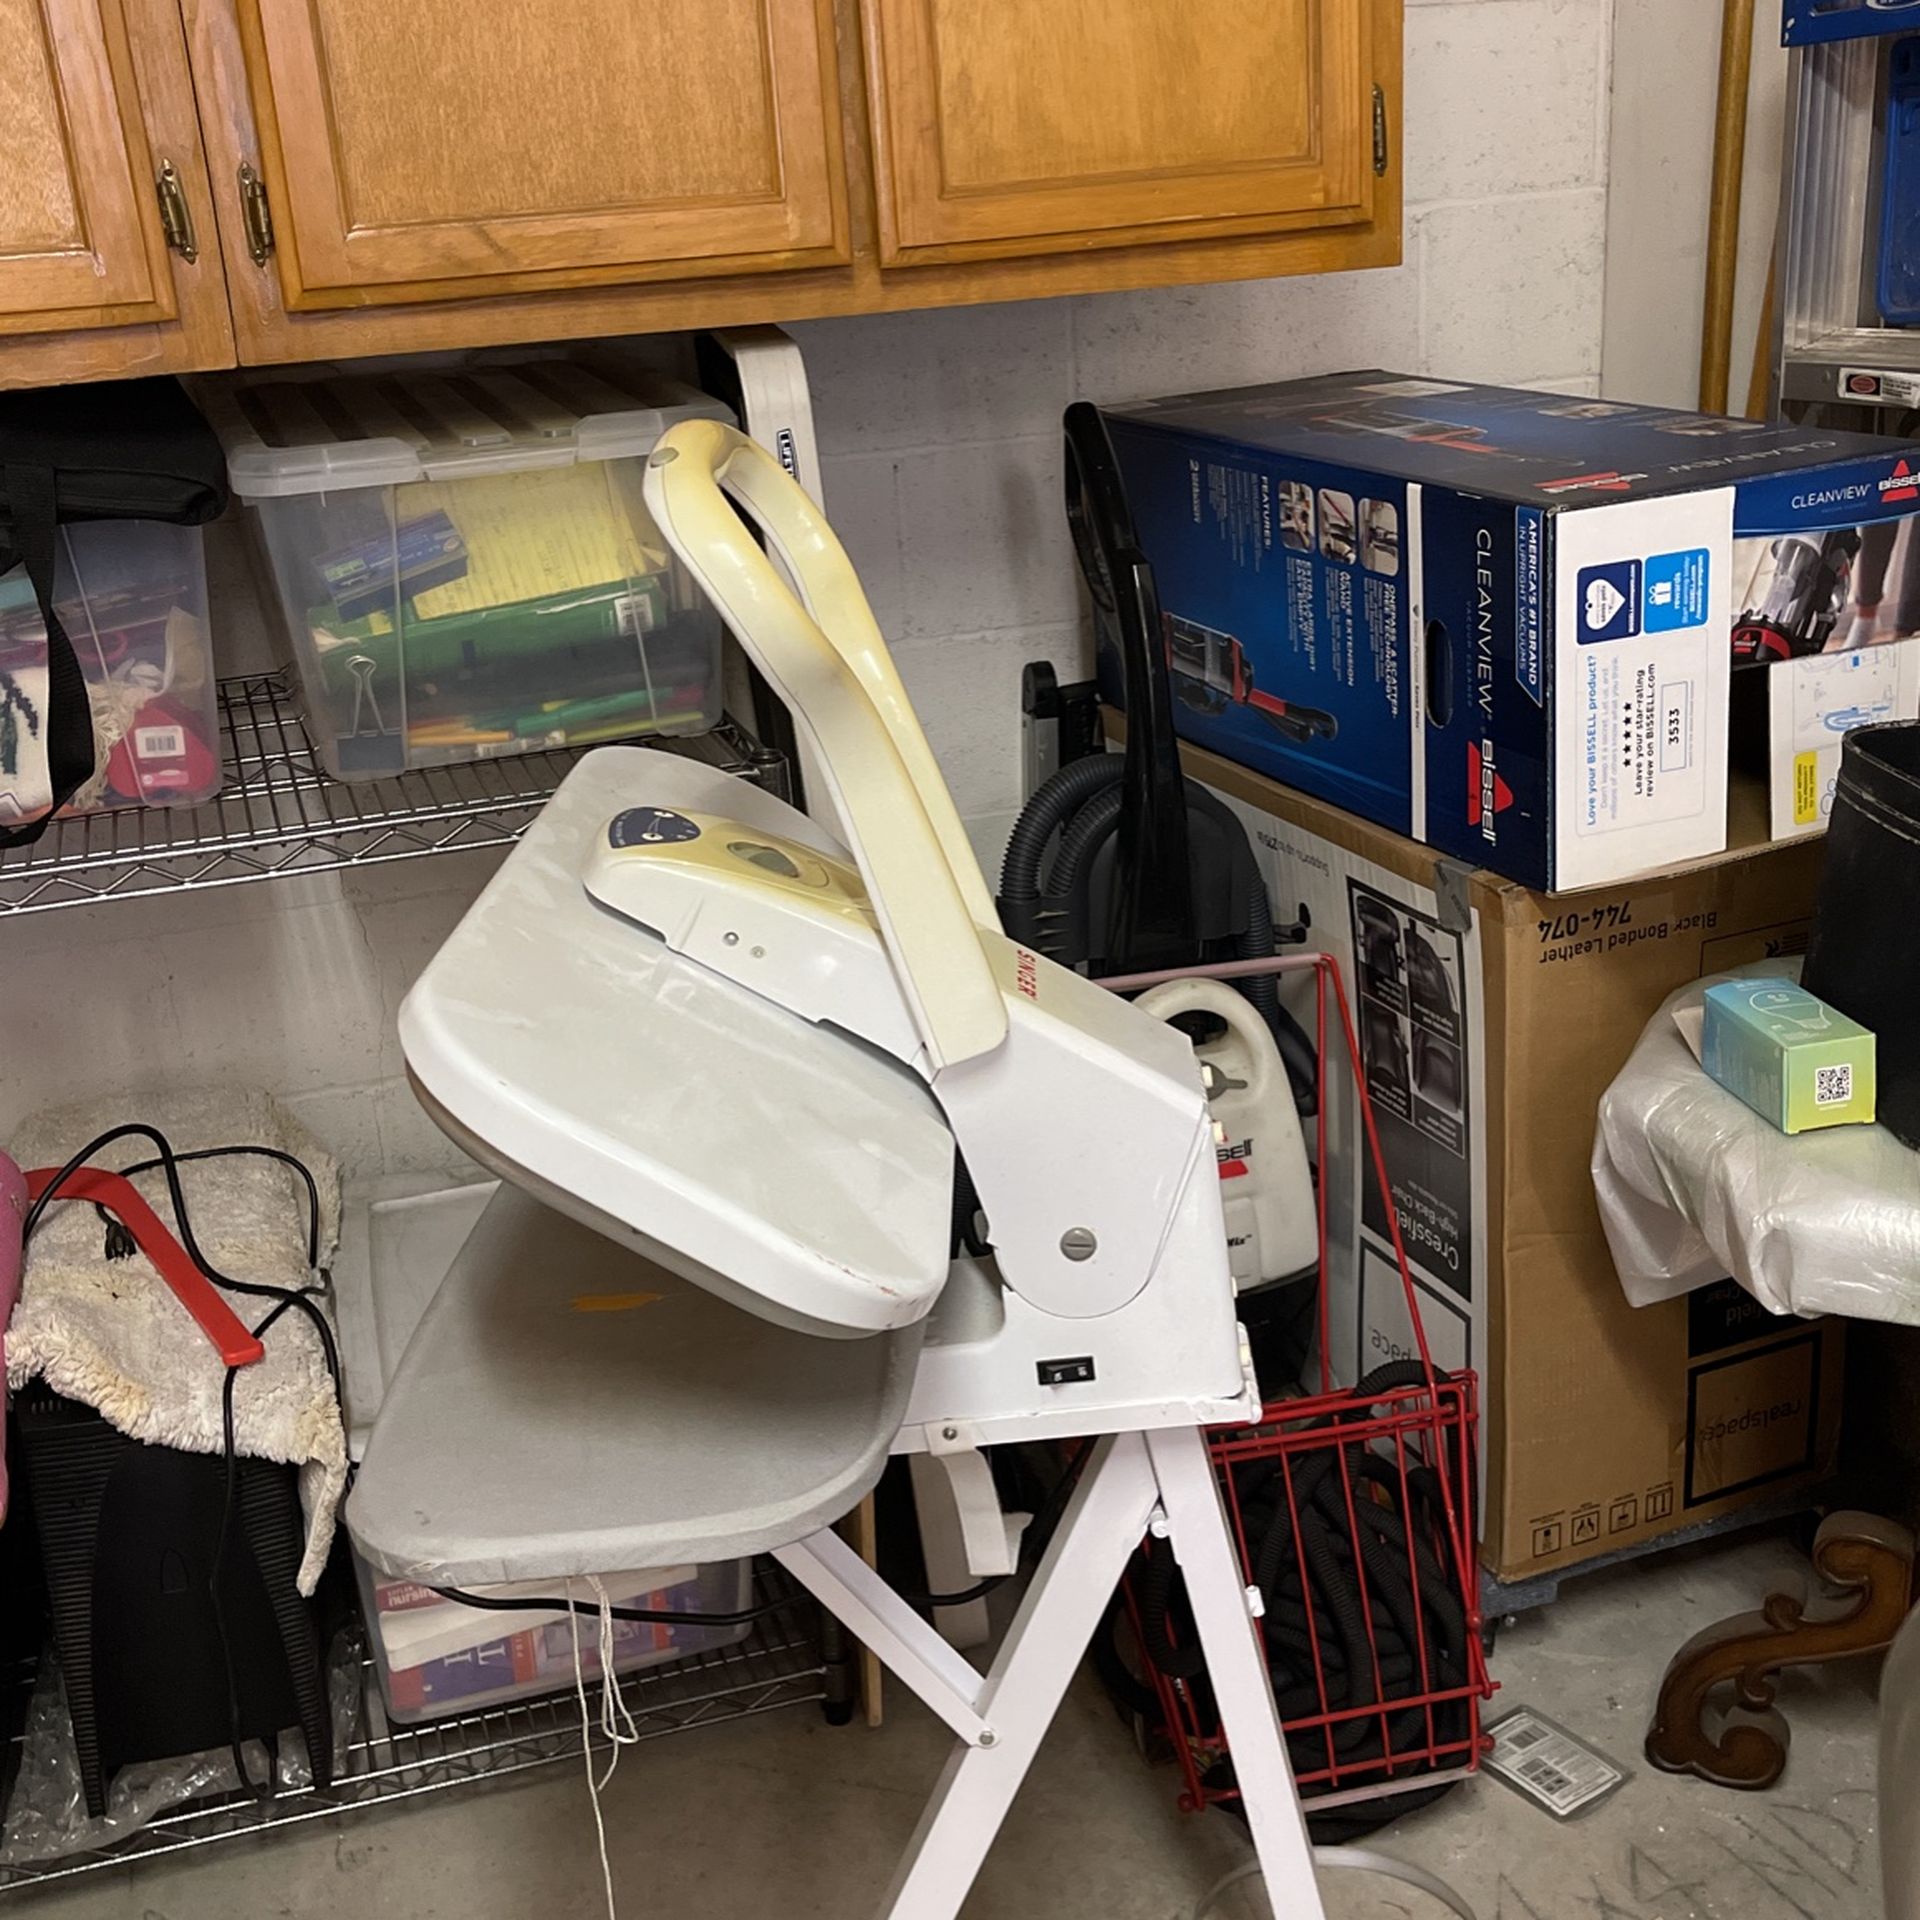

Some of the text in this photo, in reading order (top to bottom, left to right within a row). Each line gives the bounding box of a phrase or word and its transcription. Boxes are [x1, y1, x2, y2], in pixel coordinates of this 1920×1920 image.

[1791, 483, 1871, 510] CLEANVIEW
[1476, 528, 1494, 716] CLEANVIEW
[1519, 526, 1527, 670] IN UPRIGHT VACUUMS
[1529, 518, 1537, 685] AMERICA'S #1 BRAND
[1586, 655, 1597, 826] Love your BISSELL product?
[1634, 670, 1645, 796] Leave your star-rating
[1645, 663, 1655, 797] review on BISSELL.com
[1668, 708, 1681, 746] 3533
[1537, 900, 1632, 943] 744-074
[1538, 936, 1603, 964] Leather
[1608, 922, 1669, 948] Bonded
[1017, 949, 1038, 999] SINGER
[1394, 1207, 1459, 1271] Cressfiel
